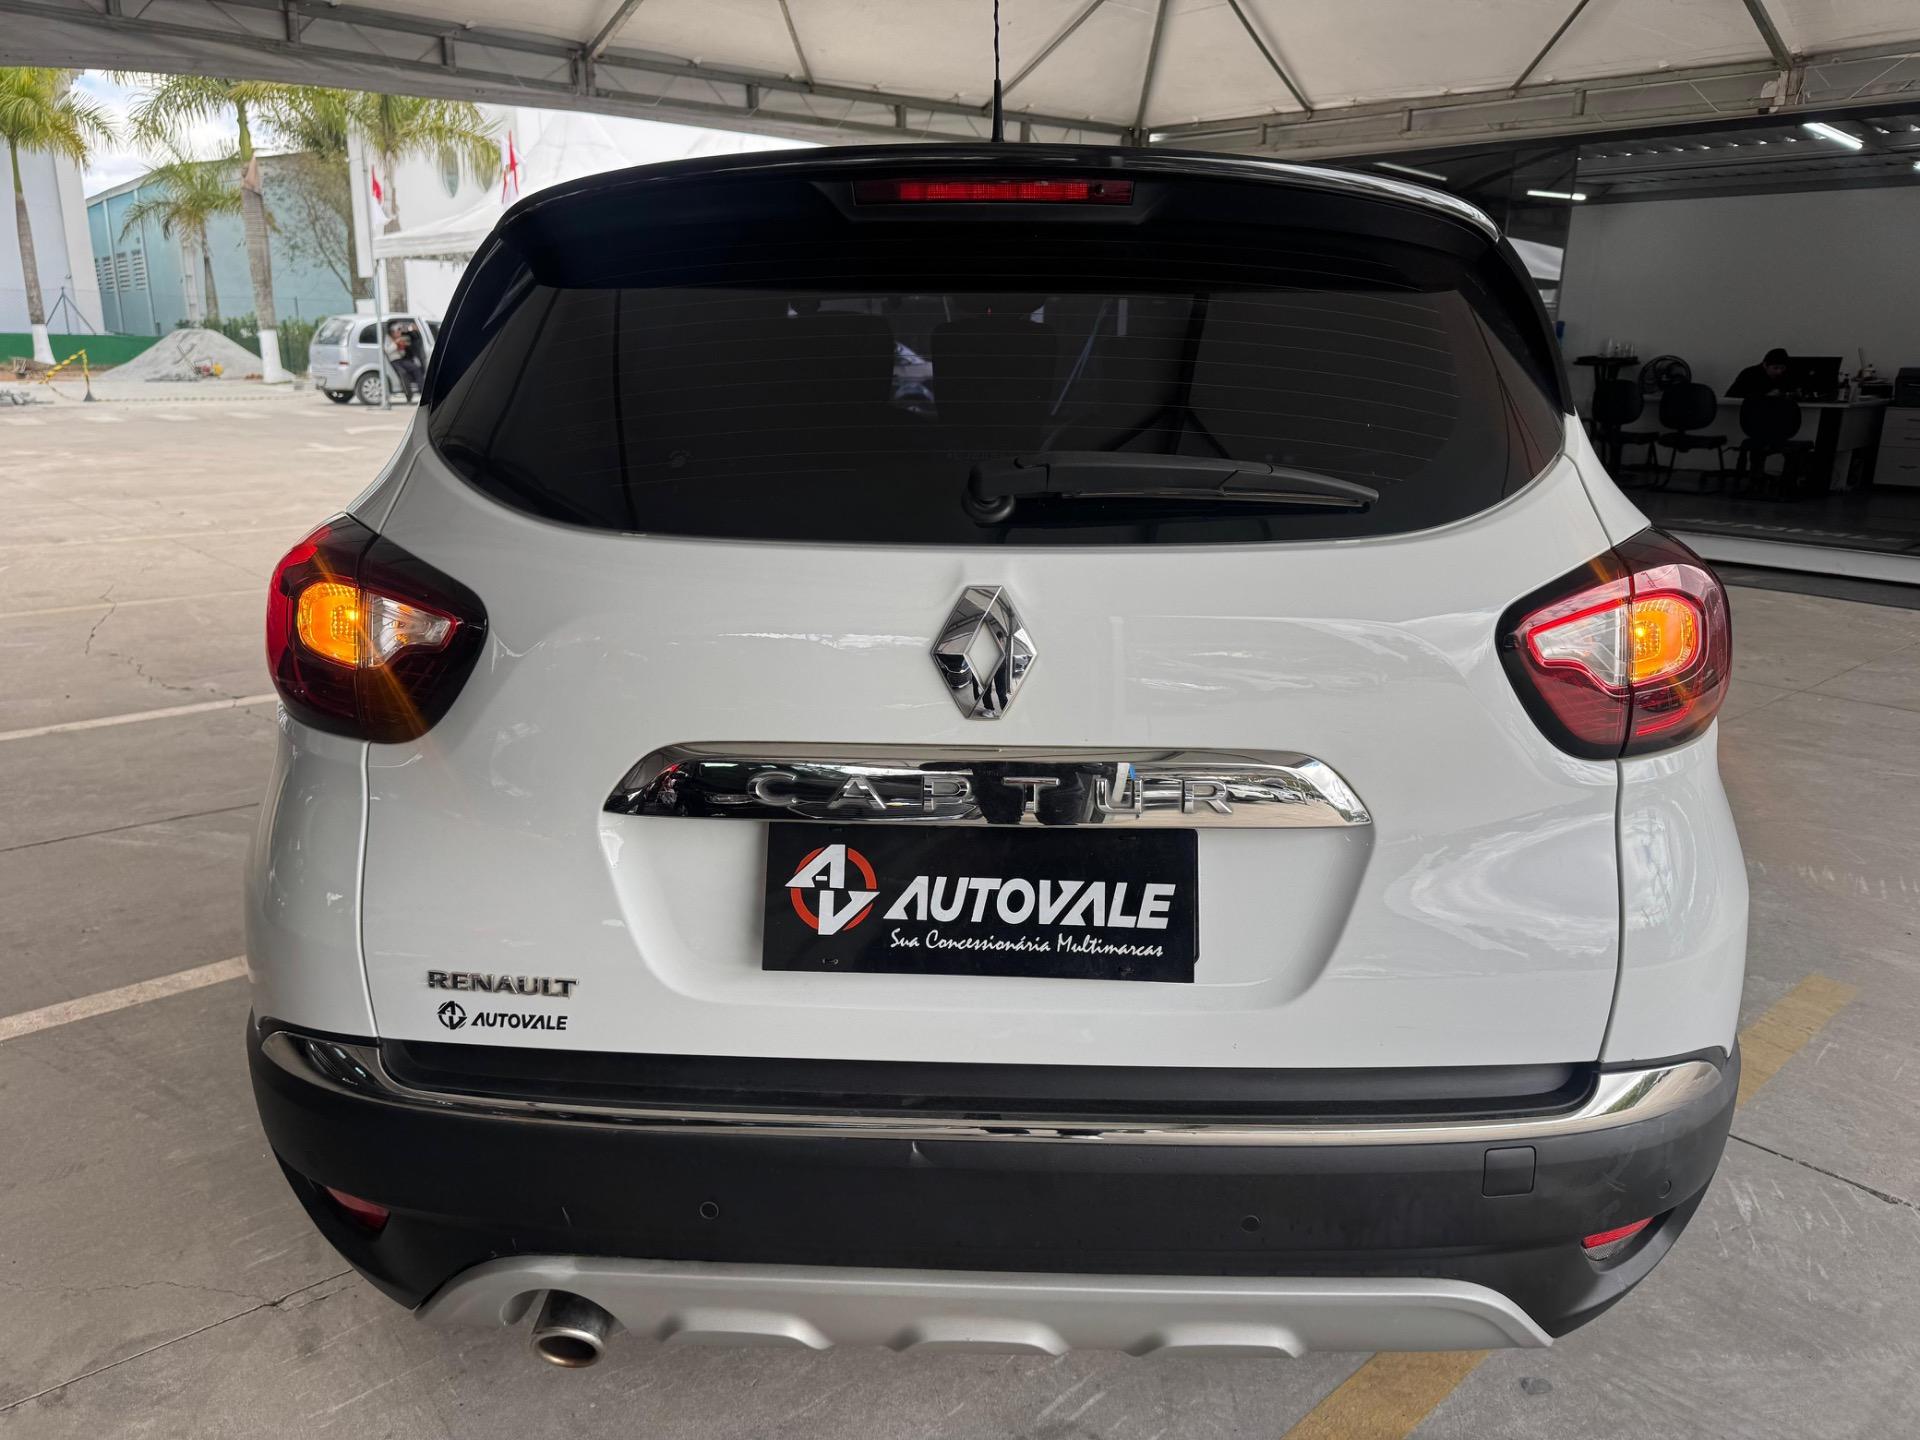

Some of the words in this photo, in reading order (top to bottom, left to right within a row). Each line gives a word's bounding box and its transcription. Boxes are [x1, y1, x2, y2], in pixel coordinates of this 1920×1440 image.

[745, 770, 1234, 815] CAPTUR
[883, 875, 1176, 929] AUTOVALE
[890, 927, 920, 948] Sua
[925, 929, 1051, 952] Concessionária
[1056, 932, 1163, 957] Multimarcas
[427, 969, 579, 999] RENAULT
[471, 1012, 568, 1030] AUTOVALE
